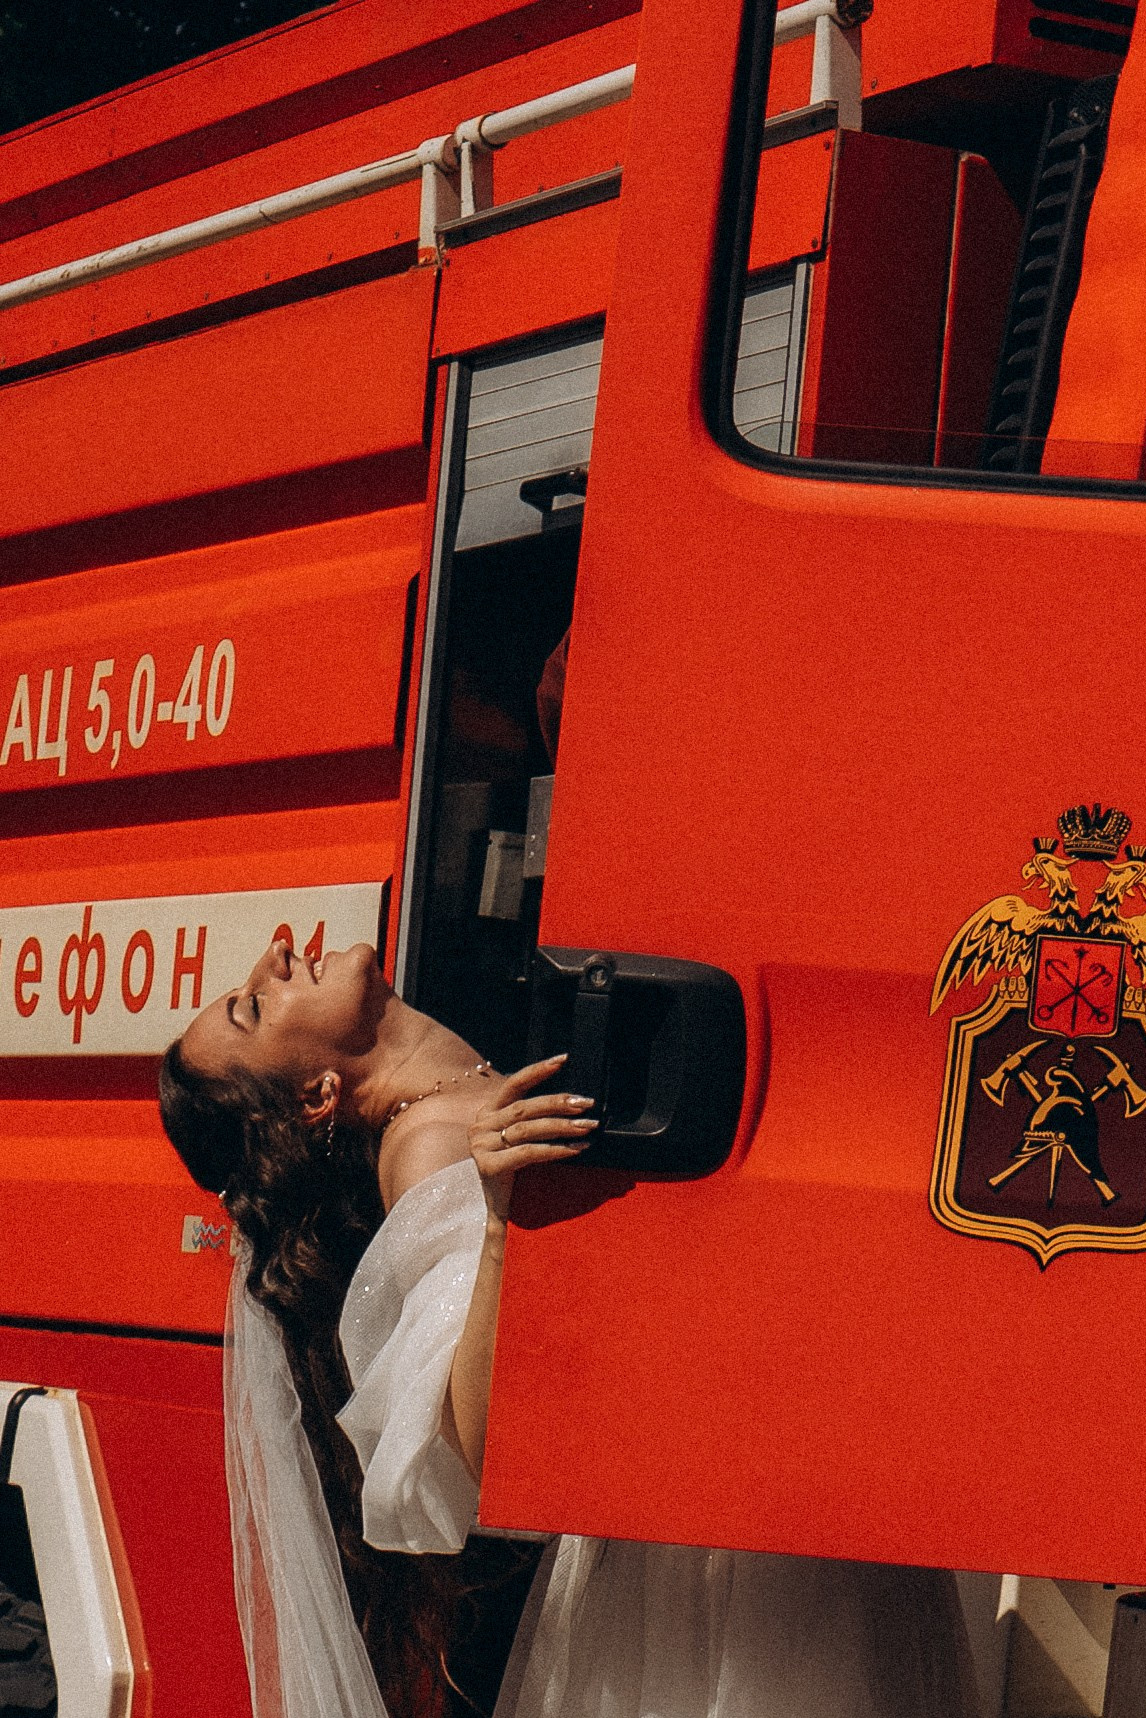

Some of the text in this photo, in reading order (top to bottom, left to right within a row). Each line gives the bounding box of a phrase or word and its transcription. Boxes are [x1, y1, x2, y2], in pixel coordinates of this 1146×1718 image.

[0, 638, 236, 776] АЦ 5,0-40
[0, 905, 208, 1044] ефон
